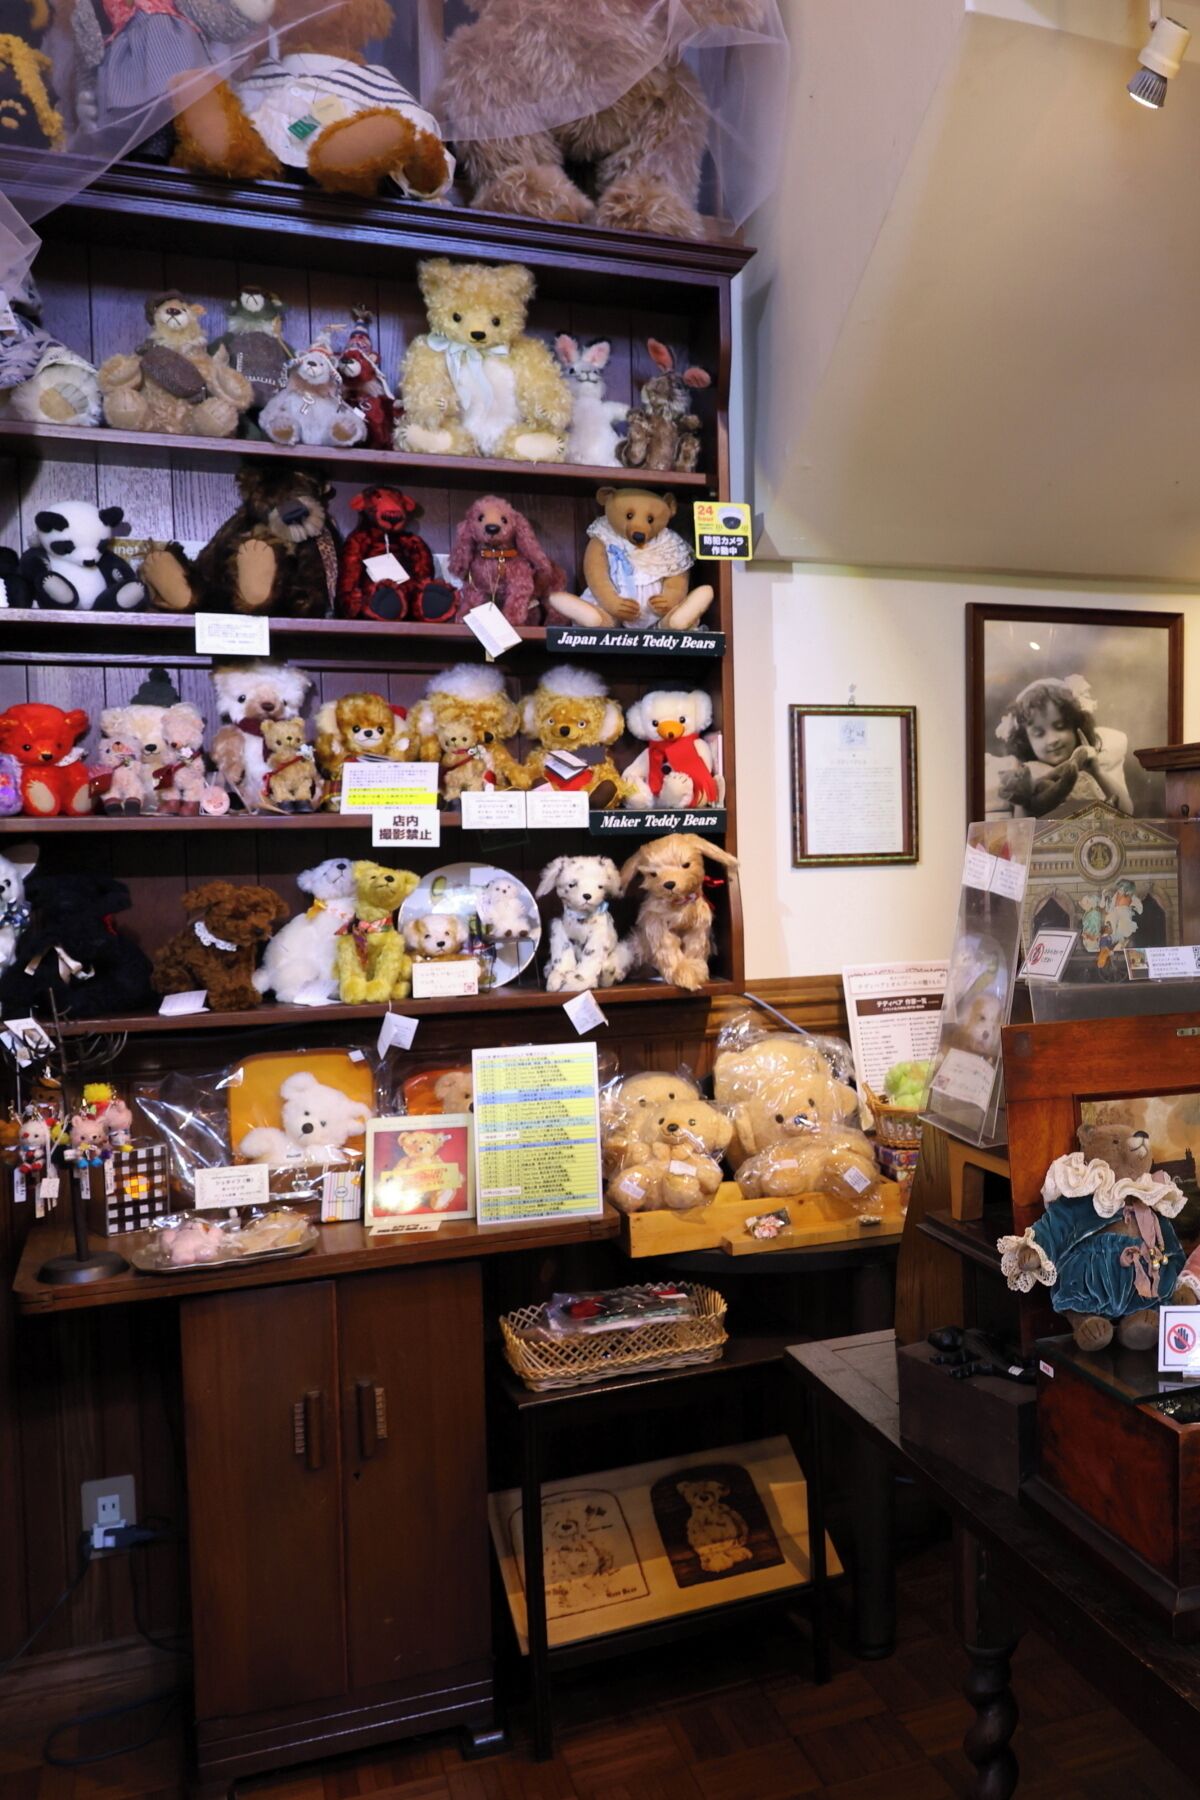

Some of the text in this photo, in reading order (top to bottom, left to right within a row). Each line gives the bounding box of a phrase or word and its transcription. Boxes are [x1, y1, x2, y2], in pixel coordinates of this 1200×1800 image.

[697, 505, 713, 516] 24
[703, 535, 744, 546] 防犯カメラ
[711, 546, 738, 556] 作動中
[558, 632, 716, 650] Japan Artist Teddy Bears
[392, 815, 419, 827] 店内
[600, 814, 718, 828] Maker Teddy Bears
[379, 828, 432, 841] 撮影禁止
